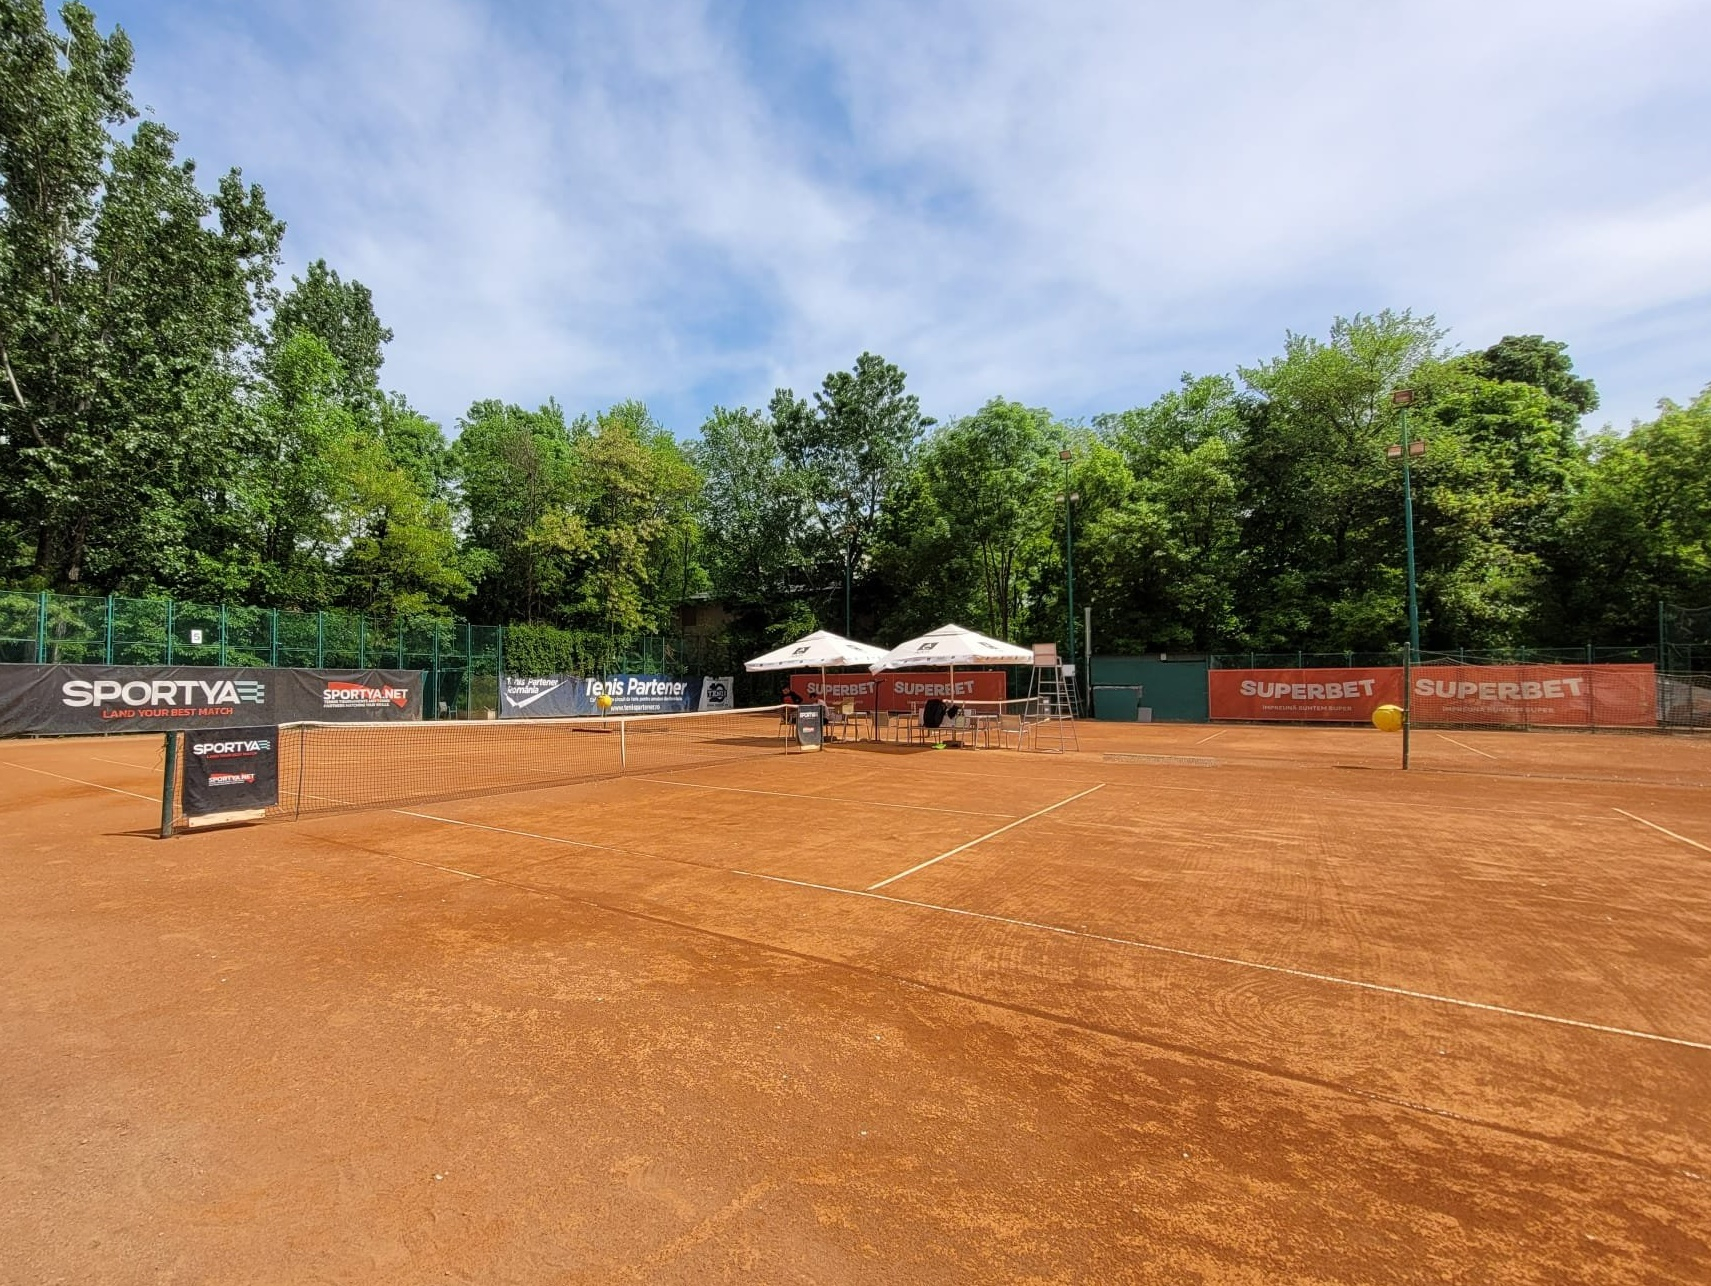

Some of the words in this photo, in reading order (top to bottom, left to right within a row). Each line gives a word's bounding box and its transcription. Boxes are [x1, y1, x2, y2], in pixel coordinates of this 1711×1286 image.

[507, 678, 525, 686] Tnis
[528, 678, 558, 687] Partener
[586, 678, 624, 696] Tenis
[627, 678, 687, 696] Partener
[807, 681, 875, 696] SUPERBET
[894, 680, 975, 696] SUPERBET
[1240, 679, 1375, 699] SUPERBET
[1414, 677, 1584, 700] SUPERBET
[62, 680, 240, 707] SPORTYA
[323, 689, 408, 699] SPORTYA.NET
[103, 709, 135, 718] LAND
[138, 709, 170, 718] YOUR
[171, 708, 196, 717] BEST
[198, 707, 233, 716] MATCH
[193, 741, 260, 755] SPORTYA
